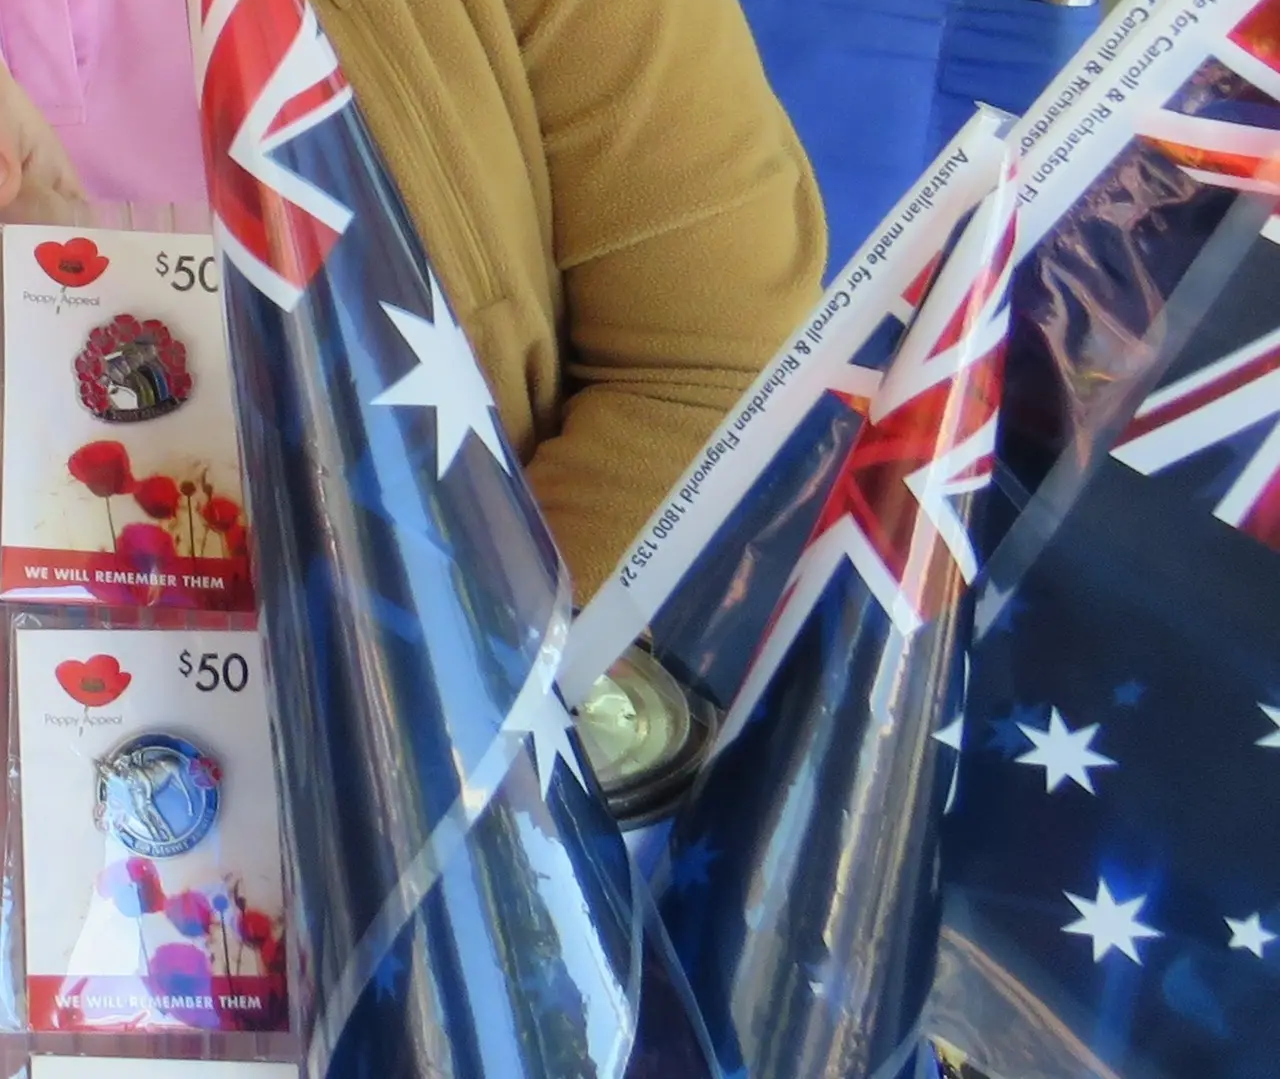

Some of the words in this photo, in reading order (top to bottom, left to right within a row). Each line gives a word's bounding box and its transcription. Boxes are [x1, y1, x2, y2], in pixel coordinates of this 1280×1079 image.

[1097, 0, 1151, 67] Carroll
[1170, 6, 1200, 37] for
[1087, 57, 1103, 75] &
[1123, 33, 1175, 93] Carroll
[1106, 87, 1126, 104] &
[1036, 101, 1113, 187] Richardson
[902, 147, 971, 223] Australian
[866, 221, 905, 264] made
[849, 265, 873, 292] for
[23, 290, 56, 306] Poppy
[60, 291, 101, 307] Appeal
[806, 291, 851, 344] Carroll
[793, 340, 812, 355] &
[734, 354, 801, 432] Richardson
[679, 431, 741, 505] Flagworld
[652, 503, 687, 541] 1800
[631, 538, 659, 569] 135
[24, 566, 49, 580] WE
[54, 568, 90, 583] WILL
[95, 570, 177, 587] REMEMBER
[182, 575, 225, 591] THEM
[178, 649, 250, 694] $50
[44, 713, 79, 728] Poppy
[83, 713, 124, 728] Appeal
[54, 995, 81, 1009] WE
[87, 996, 124, 1010] WILL
[220, 996, 262, 1010] THEM
